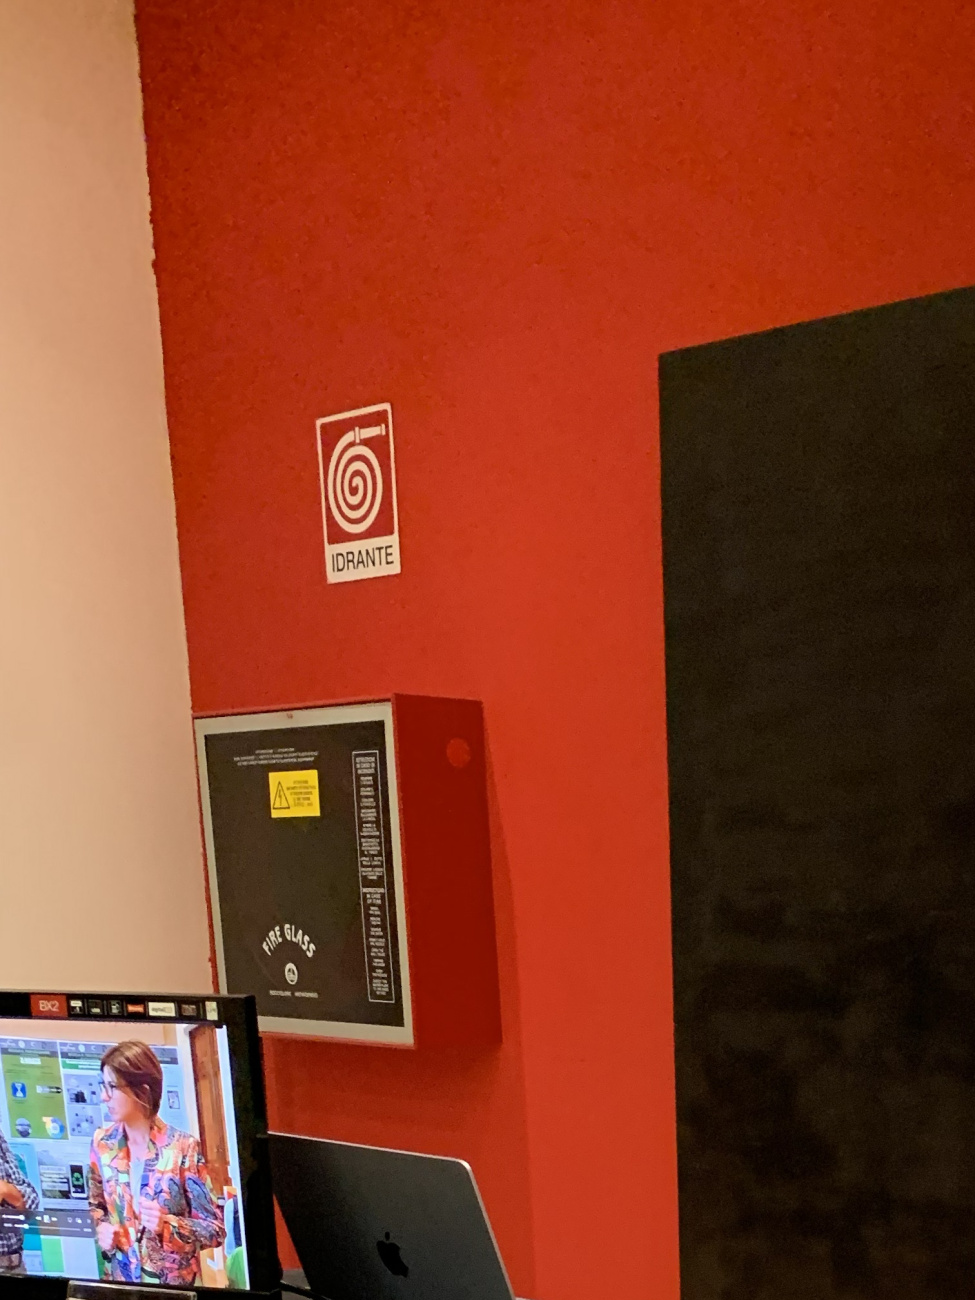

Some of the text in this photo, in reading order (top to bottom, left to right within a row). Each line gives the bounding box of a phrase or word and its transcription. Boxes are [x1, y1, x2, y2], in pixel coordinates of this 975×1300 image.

[331, 544, 394, 573] IDRANTE
[262, 923, 316, 957] FIRE GLASS
